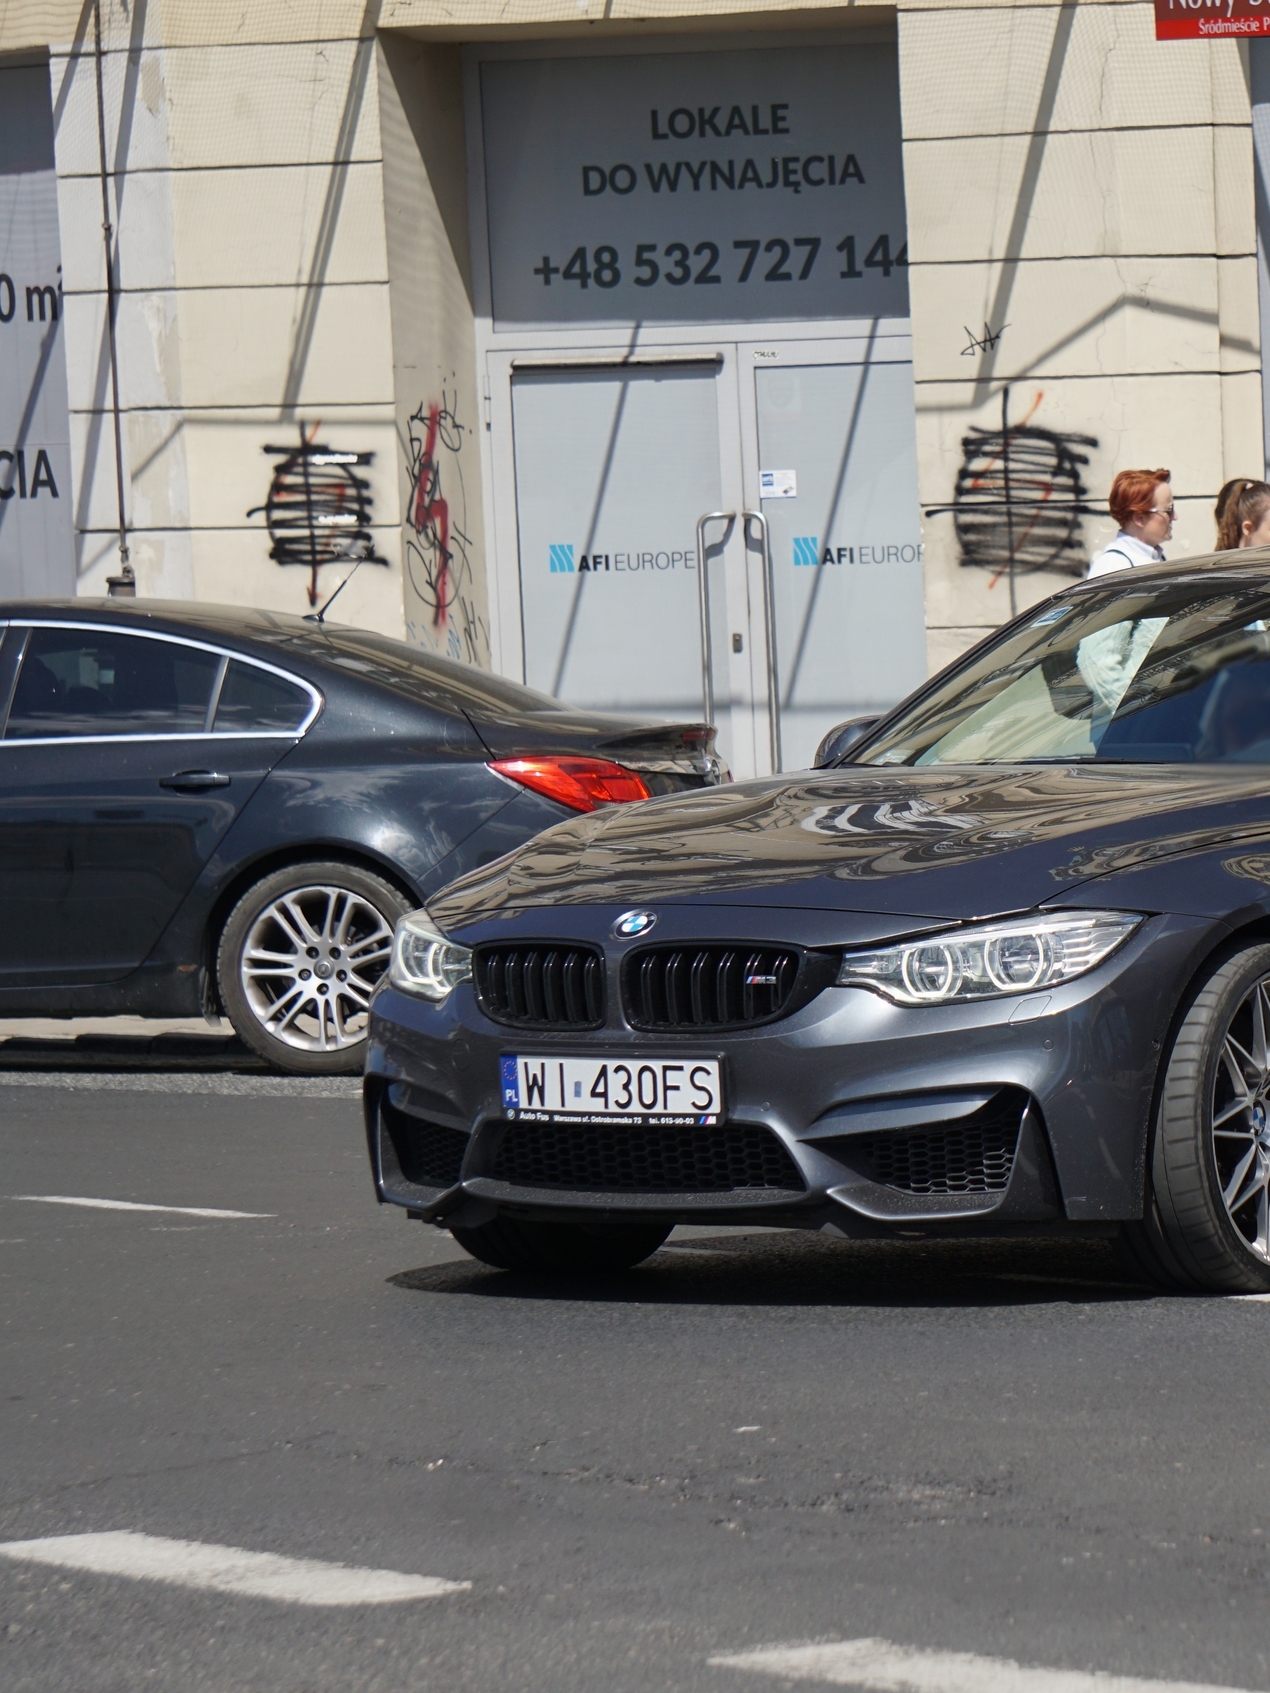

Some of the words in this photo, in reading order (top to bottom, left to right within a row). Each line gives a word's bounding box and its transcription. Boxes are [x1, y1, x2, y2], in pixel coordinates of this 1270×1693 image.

[1199, 18, 1259, 35] Śródmieście
[650, 103, 790, 140] LOKALE
[582, 163, 637, 196] DO
[645, 154, 866, 194] WYNAJĘCIA
[533, 245, 622, 289] +48
[633, 241, 722, 287] 532
[733, 237, 821, 283] 727
[578, 553, 610, 572] AFI
[615, 551, 696, 571] EUROPE
[822, 547, 854, 565] AFI
[506, 1089, 519, 1103] PL
[524, 1061, 566, 1108] WI
[589, 1064, 714, 1112] 430FS
[519, 1111, 536, 1120] Auto
